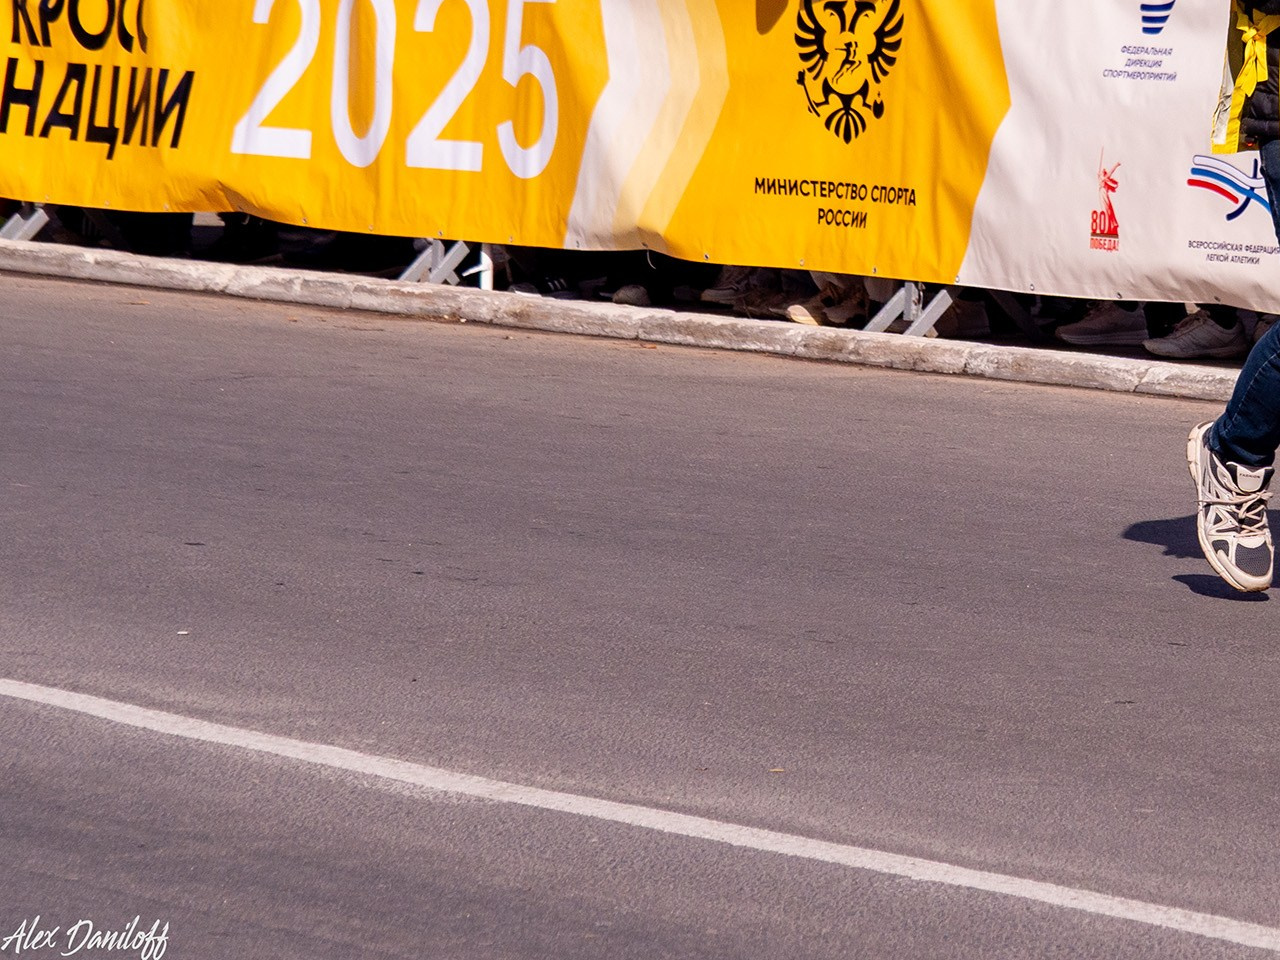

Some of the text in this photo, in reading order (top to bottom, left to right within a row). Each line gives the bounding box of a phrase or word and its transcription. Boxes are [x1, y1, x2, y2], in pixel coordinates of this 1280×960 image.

[1120, 45, 1173, 56] ФЕДЕРАЛЬНАЯ
[1125, 58, 1163, 69] ДИРЕКЦИЯ
[1102, 69, 1178, 81] СПОРТМЕРОПРИЯТИЙ
[0, 56, 196, 161] НАЦИИ
[754, 177, 917, 206] МИНИСТЕРСТВО СПОРТА
[817, 208, 868, 229] РОССИИ
[1091, 210, 1106, 234] 80
[1090, 237, 1120, 252] ПОБЕДА!
[1188, 240, 1280, 255] ВСЕРОССИЙСКАЯ ФЕДЕРАЦИЯ
[1206, 252, 1260, 265] ЛЕГКОЙ АТЛЕТИКИ
